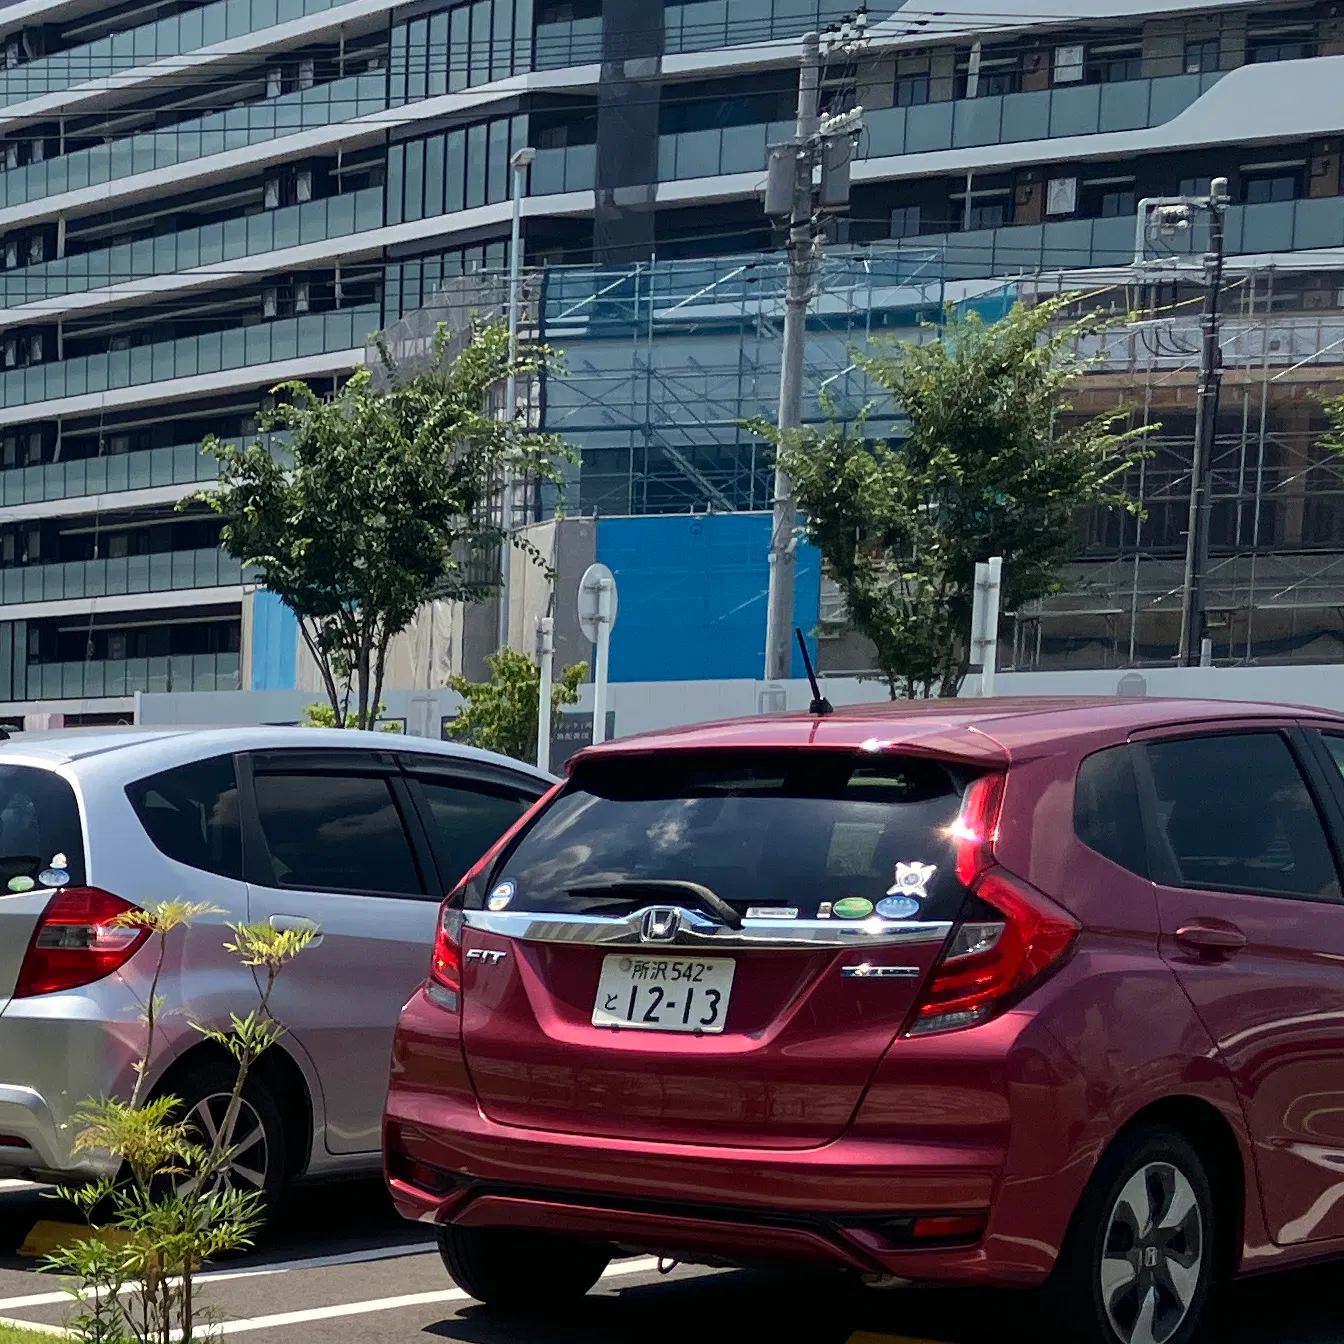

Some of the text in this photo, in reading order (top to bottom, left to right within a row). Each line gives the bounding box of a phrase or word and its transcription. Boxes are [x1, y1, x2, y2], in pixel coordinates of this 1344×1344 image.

[631, 960, 706, 983] 所沢 542
[604, 984, 722, 1026] と 12-13
